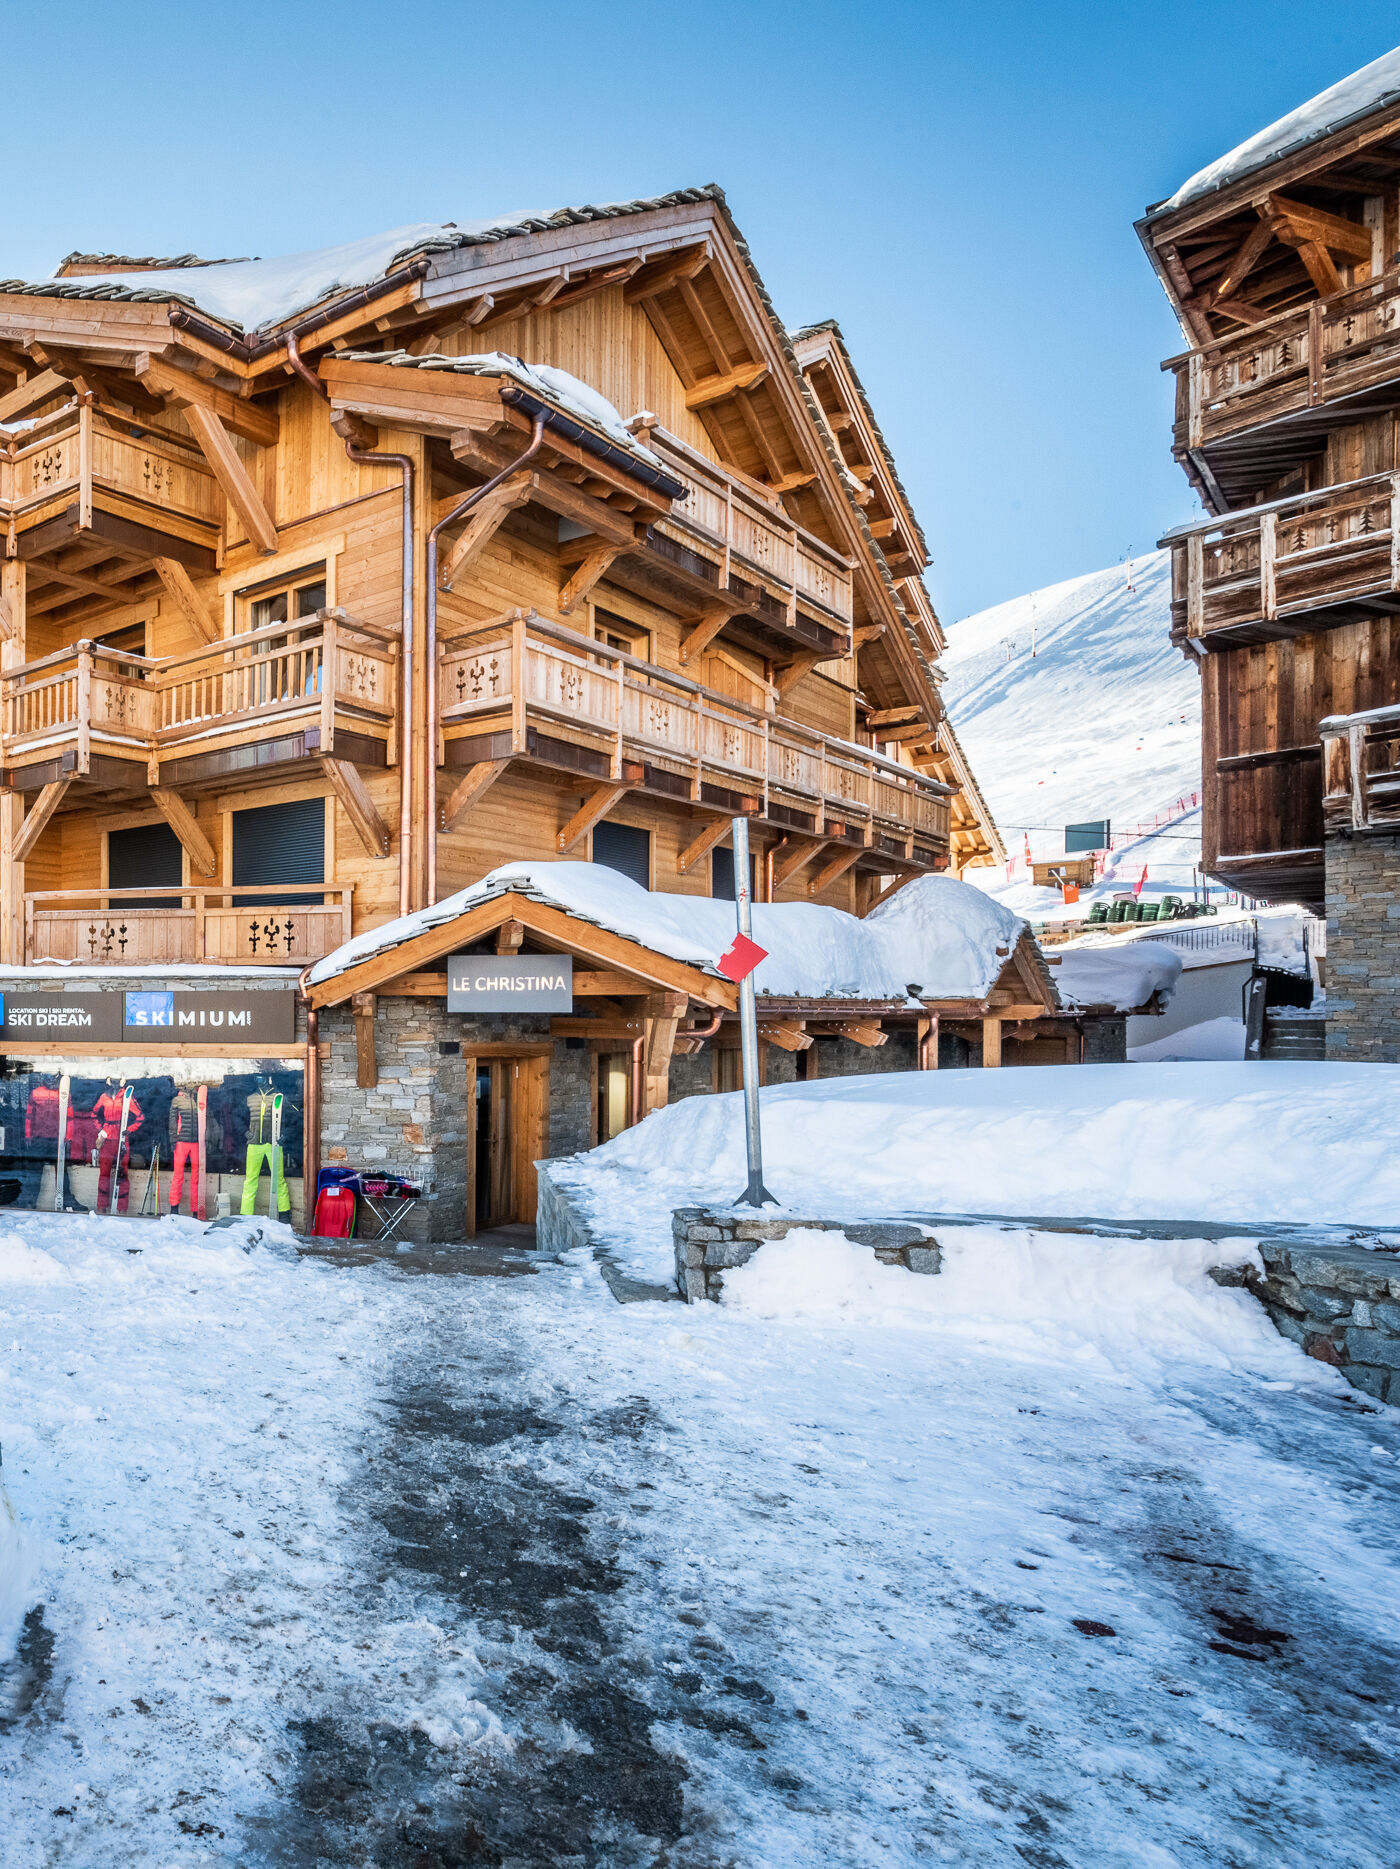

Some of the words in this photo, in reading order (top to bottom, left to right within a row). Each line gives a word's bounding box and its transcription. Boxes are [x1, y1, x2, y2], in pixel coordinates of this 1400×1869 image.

[452, 977, 471, 992] LE
[474, 976, 567, 992] CHRISTINA
[8, 1013, 32, 1026] SKI
[36, 1013, 92, 1026] DREAM
